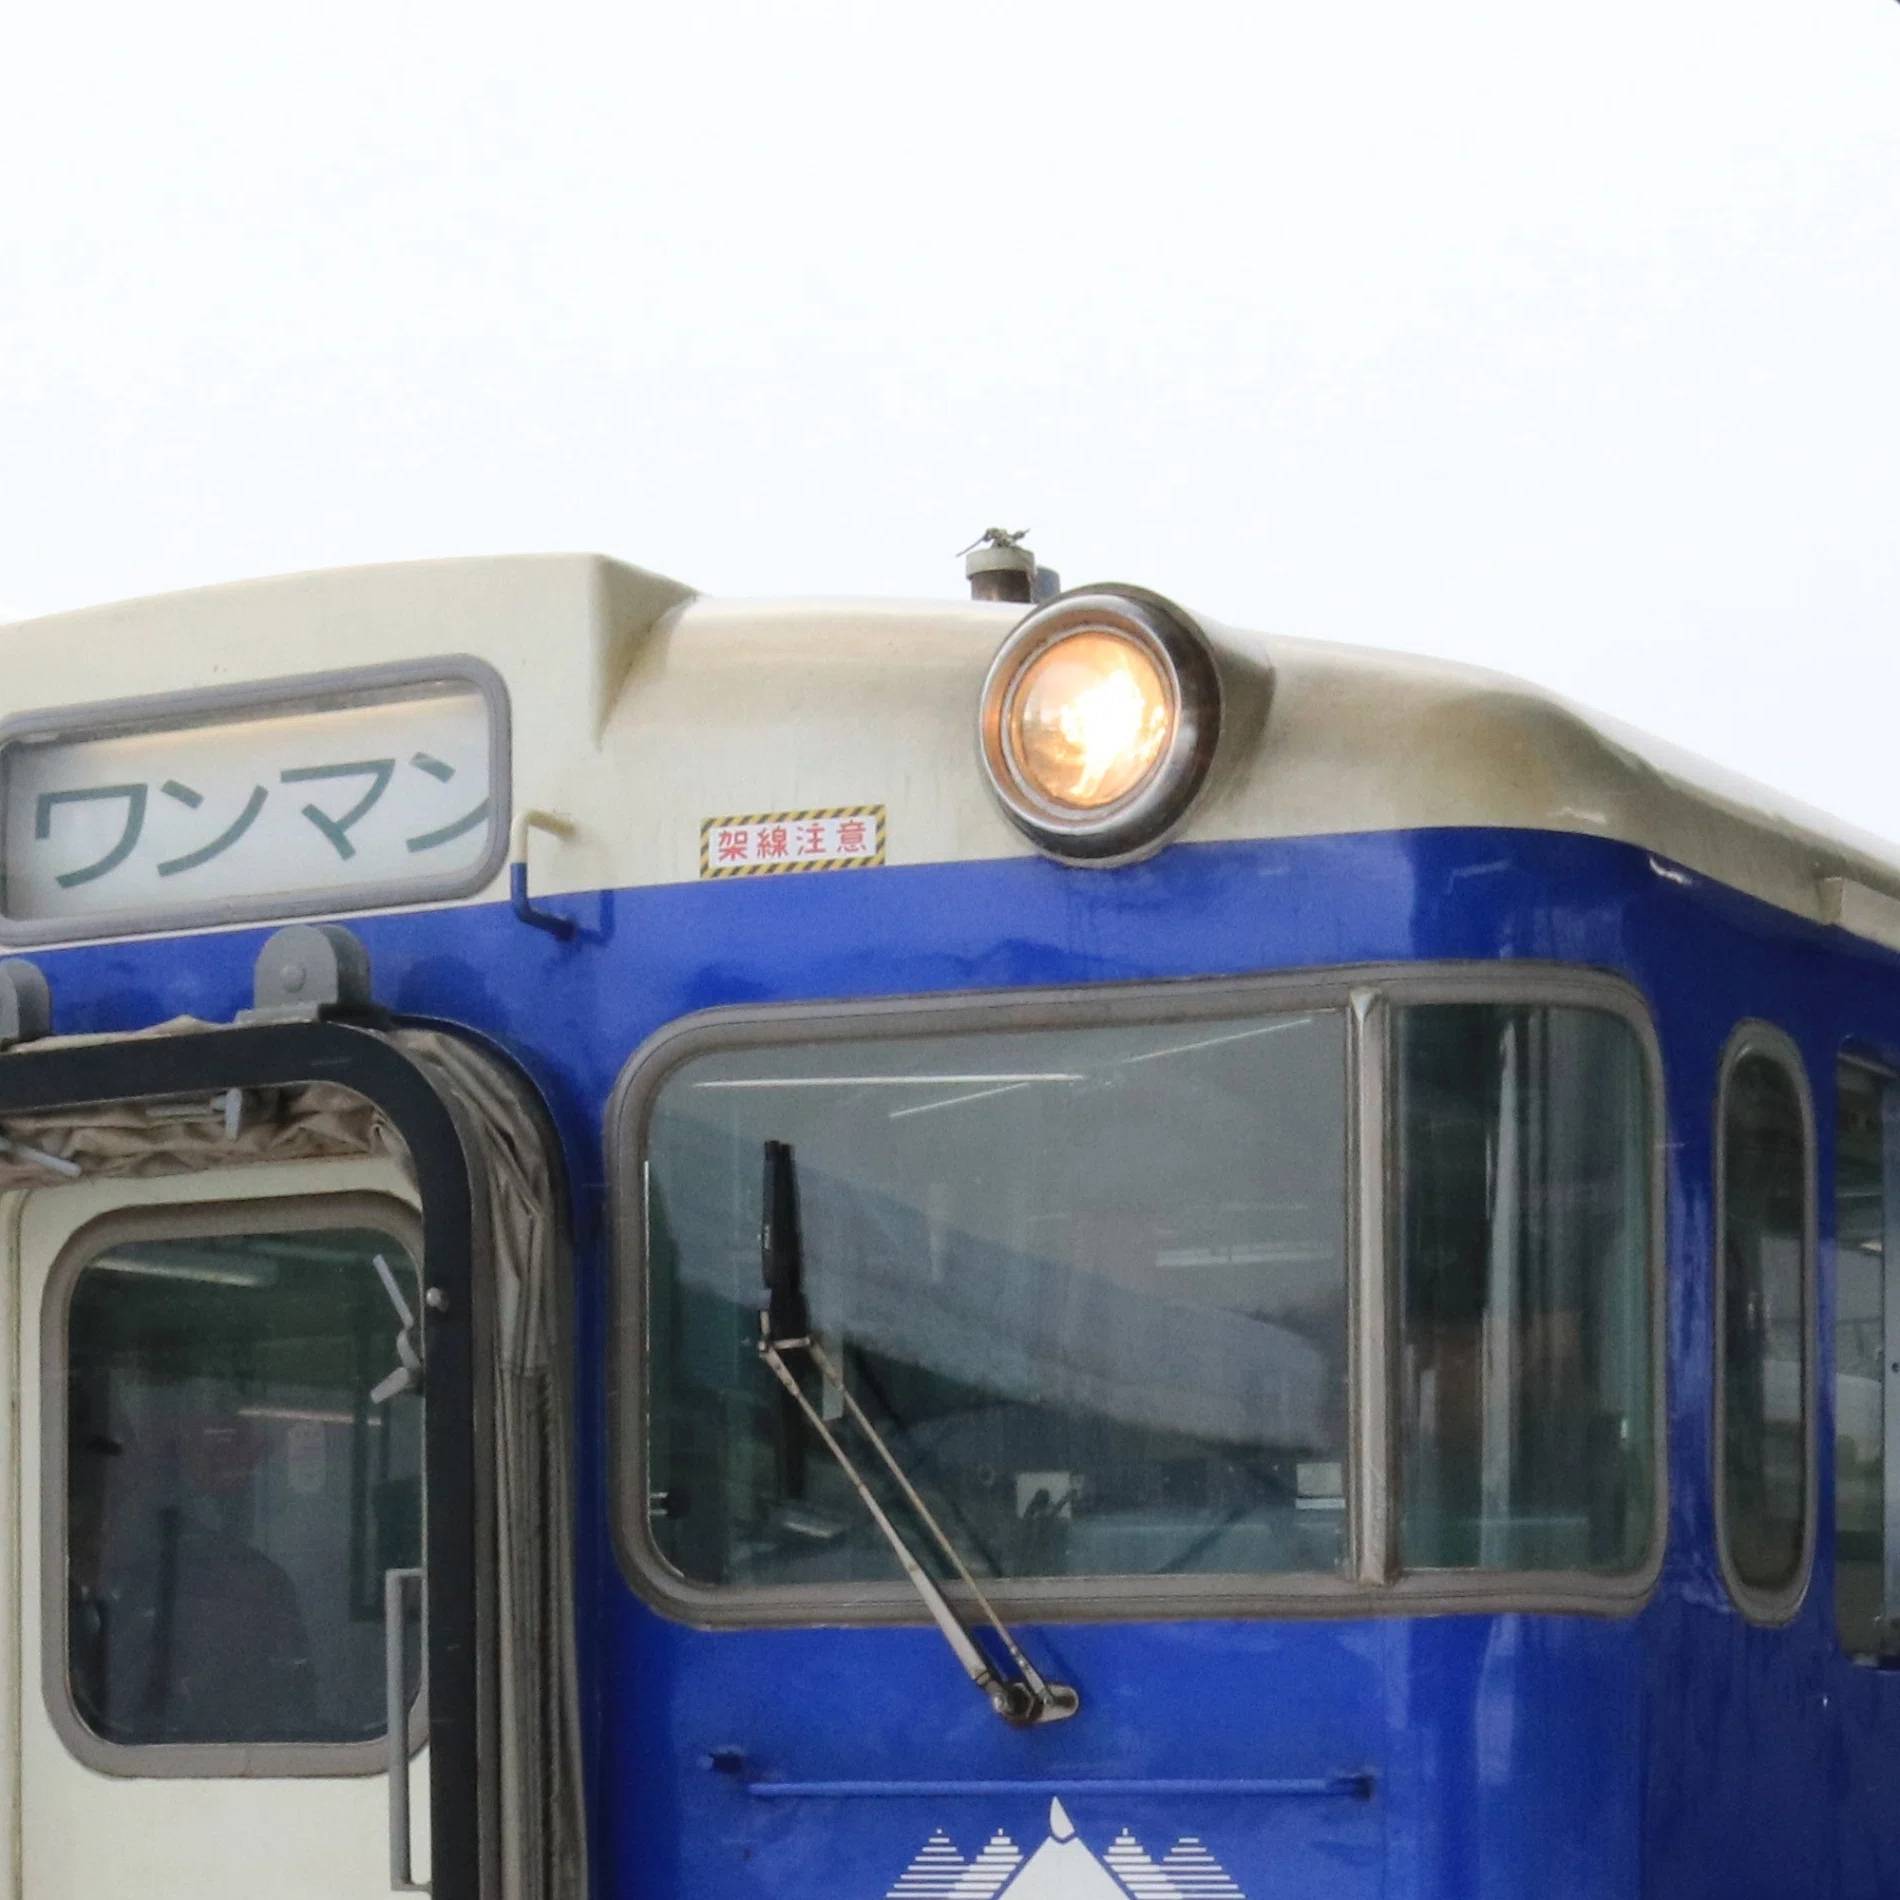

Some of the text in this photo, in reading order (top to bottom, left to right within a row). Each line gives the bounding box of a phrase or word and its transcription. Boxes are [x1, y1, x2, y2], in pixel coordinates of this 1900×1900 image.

[35, 752, 491, 889] ワンマン
[717, 818, 867, 862] 架線注意
